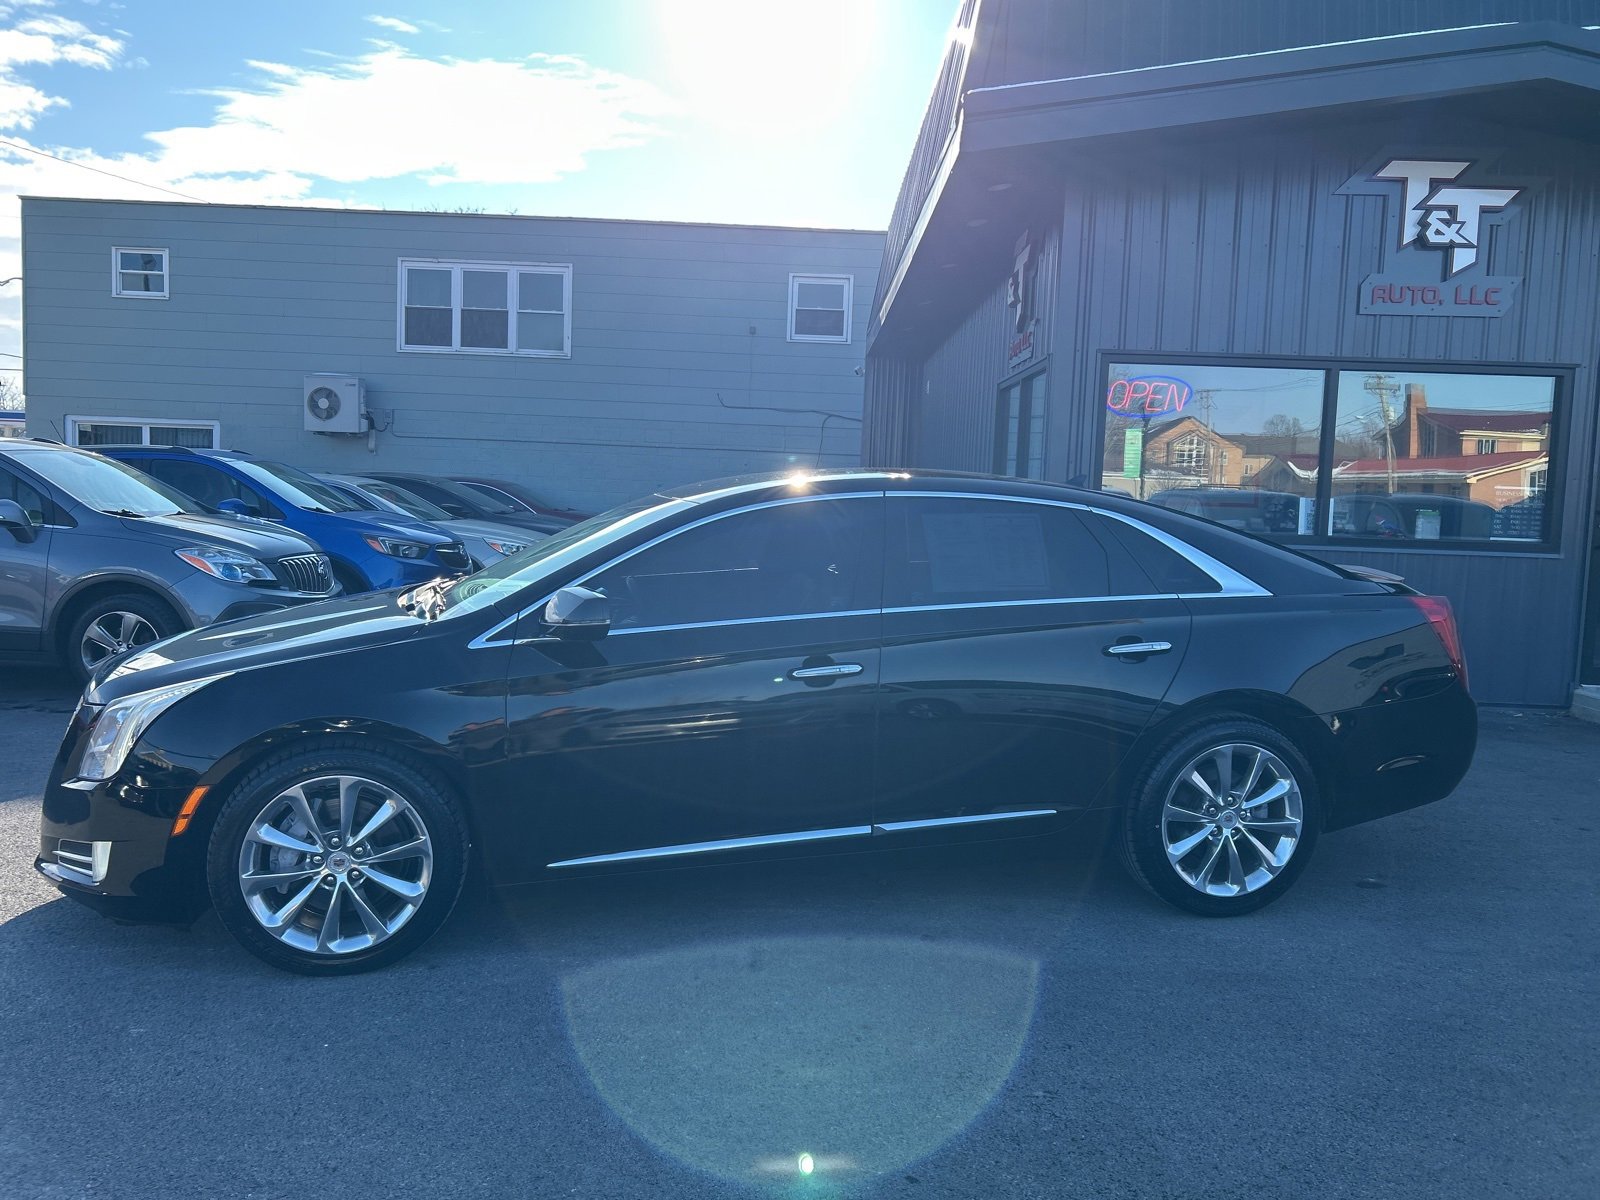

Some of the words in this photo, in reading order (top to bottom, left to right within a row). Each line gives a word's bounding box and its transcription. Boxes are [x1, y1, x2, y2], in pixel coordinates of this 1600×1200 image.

[1371, 283, 1444, 306] AUTO,
[1454, 284, 1503, 306] LLC
[1107, 380, 1189, 412] OPEN
